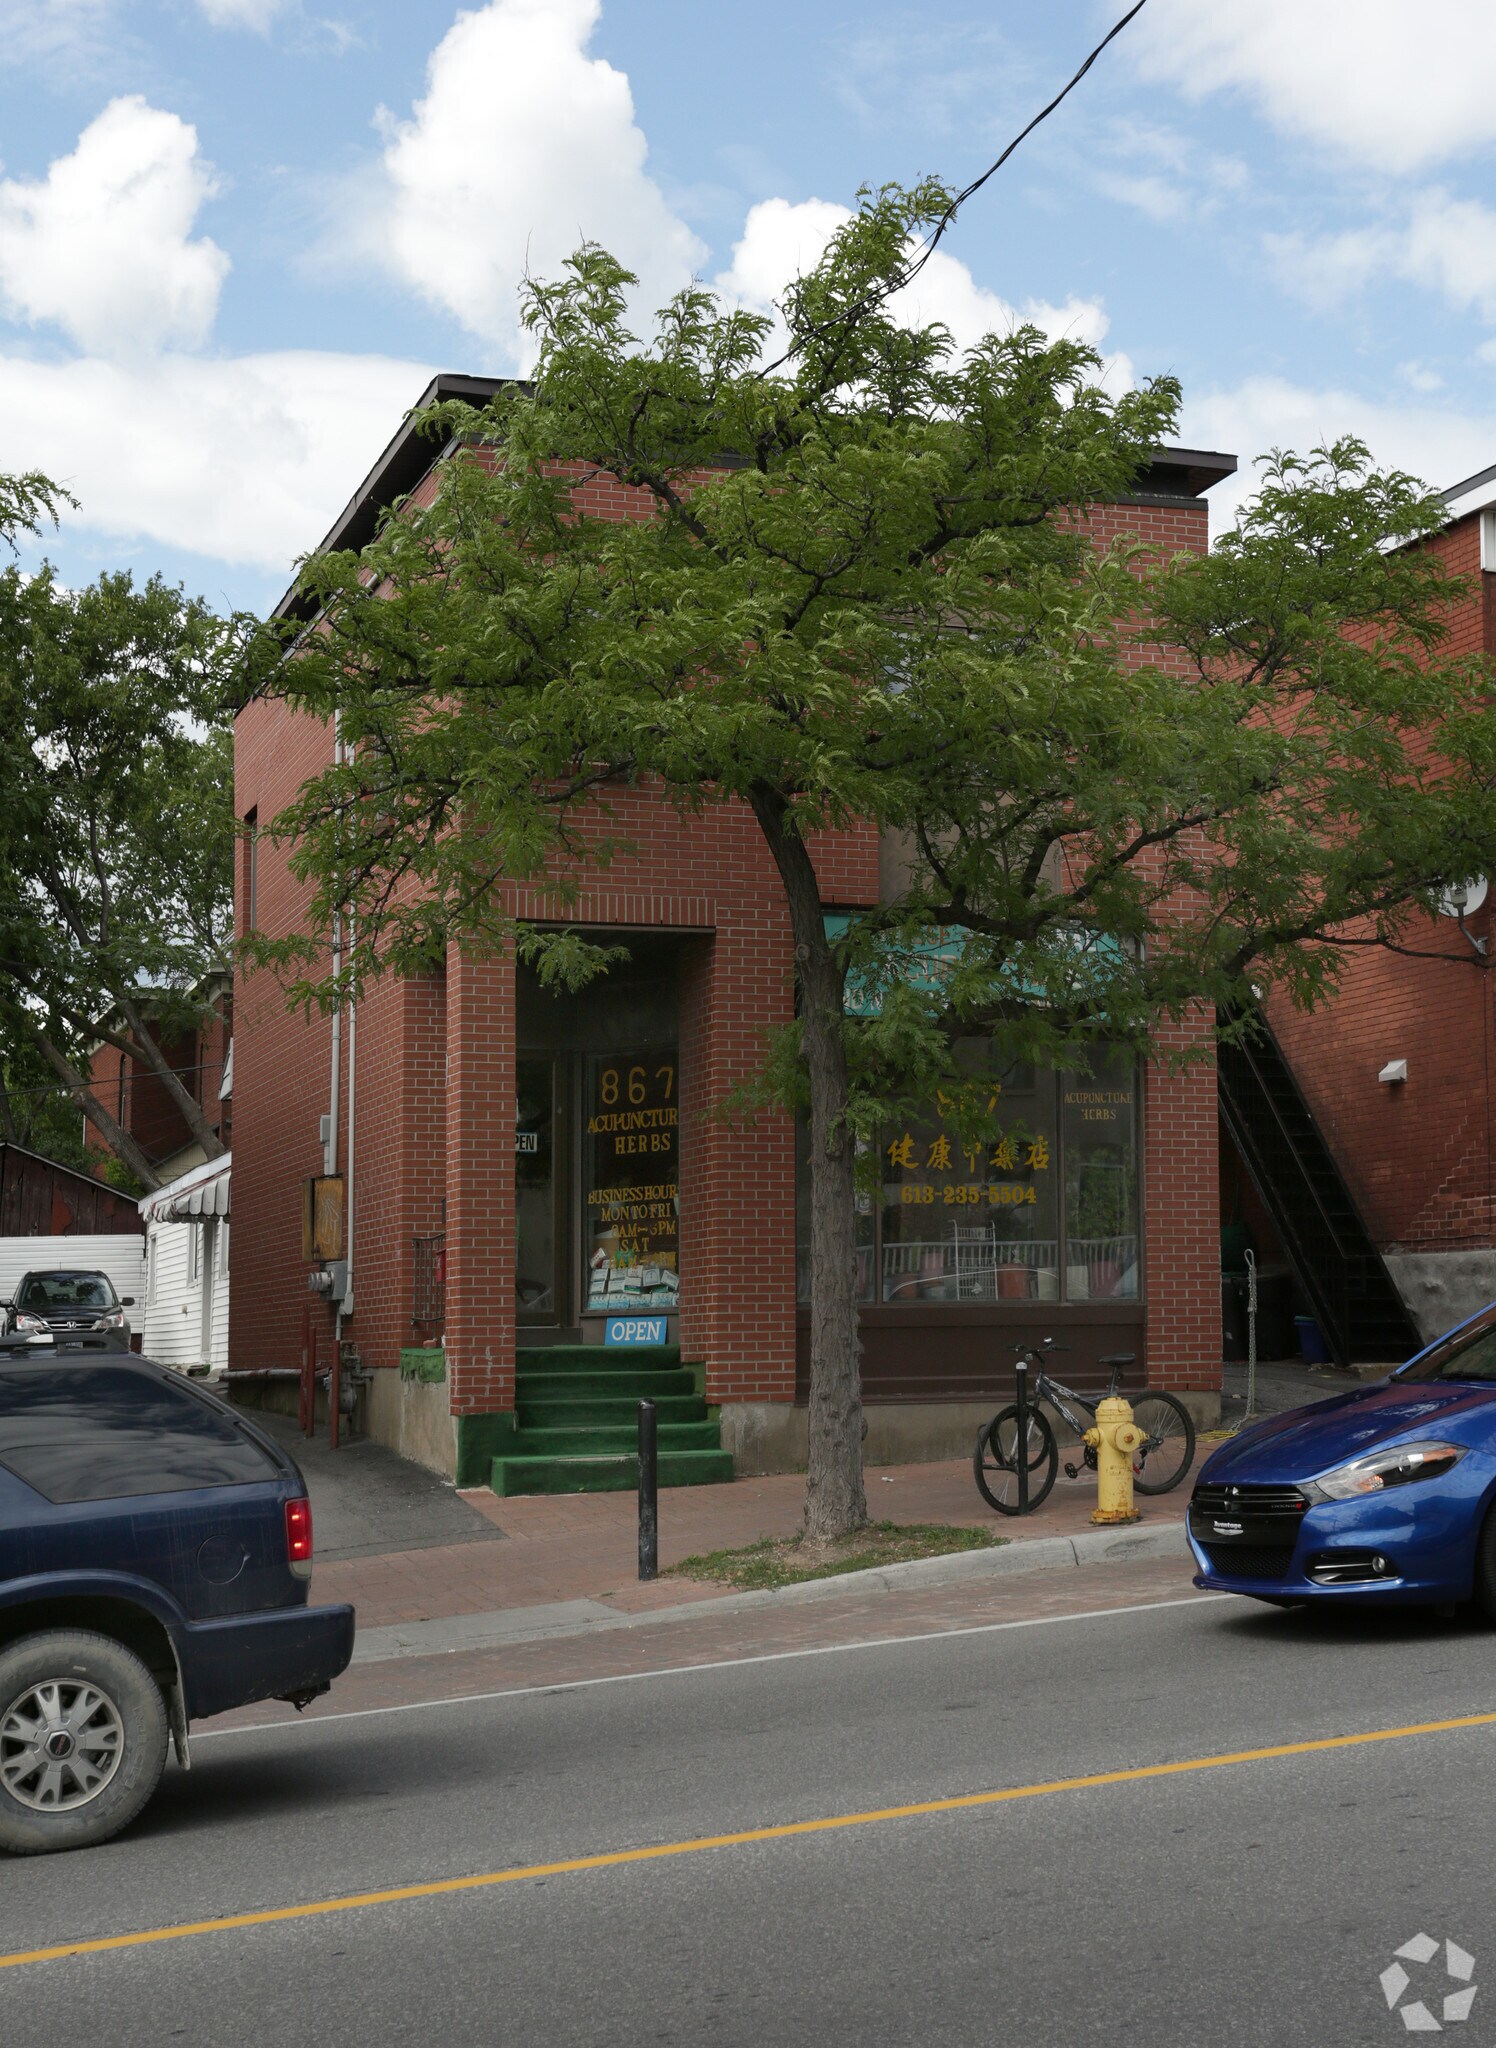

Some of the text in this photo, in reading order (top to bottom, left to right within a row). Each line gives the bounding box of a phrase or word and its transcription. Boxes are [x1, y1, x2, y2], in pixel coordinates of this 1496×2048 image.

[601, 1066, 674, 1105] 867
[615, 1133, 671, 1154] HERBS
[587, 1187, 644, 1205] BUSINESS
[901, 1185, 1037, 1205] 613-235-5504
[601, 1202, 672, 1222] MON TO FRI
[621, 1237, 650, 1253] SAT
[611, 1321, 662, 1342] OPEN
